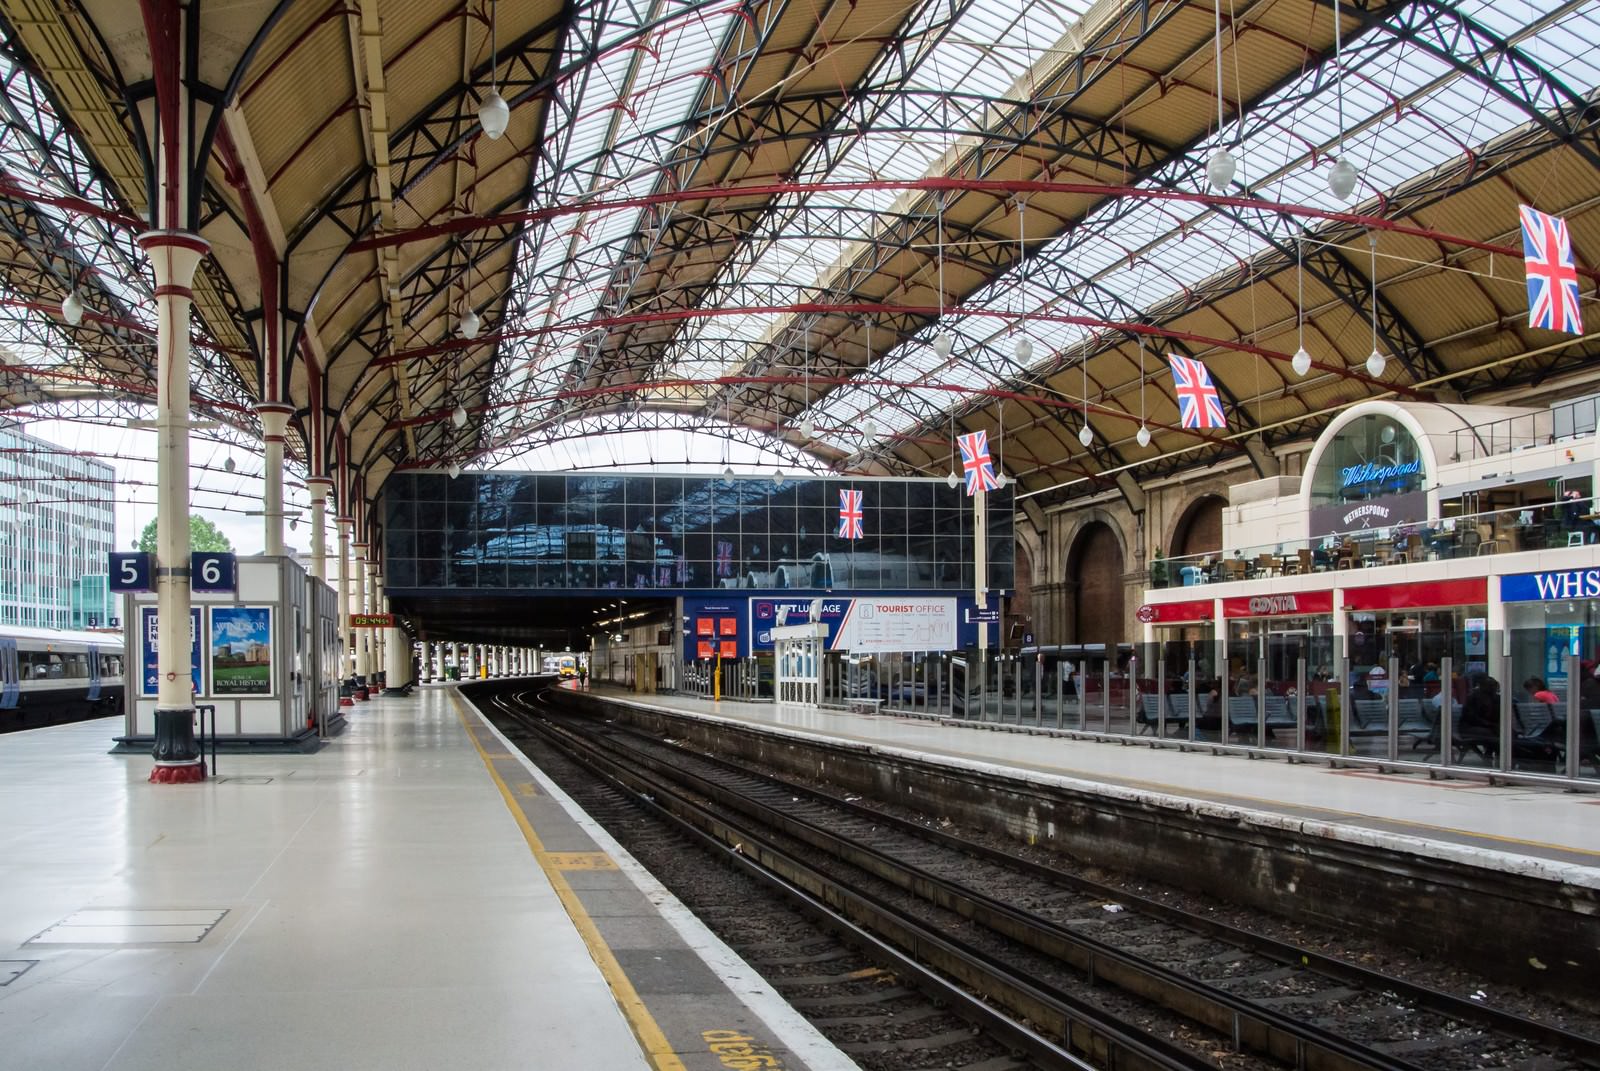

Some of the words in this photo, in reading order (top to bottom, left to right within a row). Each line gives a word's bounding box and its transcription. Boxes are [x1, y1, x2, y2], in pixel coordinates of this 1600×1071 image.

[1343, 460, 1420, 486] Wetherspoons
[1343, 504, 1390, 525] WETHERSPOONS
[120, 559, 138, 584] 5
[202, 559, 220, 584] 6
[798, 604, 841, 613] LUAGE
[1249, 594, 1297, 613] COSTA
[876, 605, 914, 613] TOURIST
[915, 605, 945, 613] OFFICE
[90, 618, 96, 626] 3
[111, 618, 116, 626] 4
[216, 621, 266, 632] WINDSOR
[1026, 634, 1032, 642] 8
[216, 679, 239, 687] ROYAL
[239, 679, 268, 687] HISTORY
